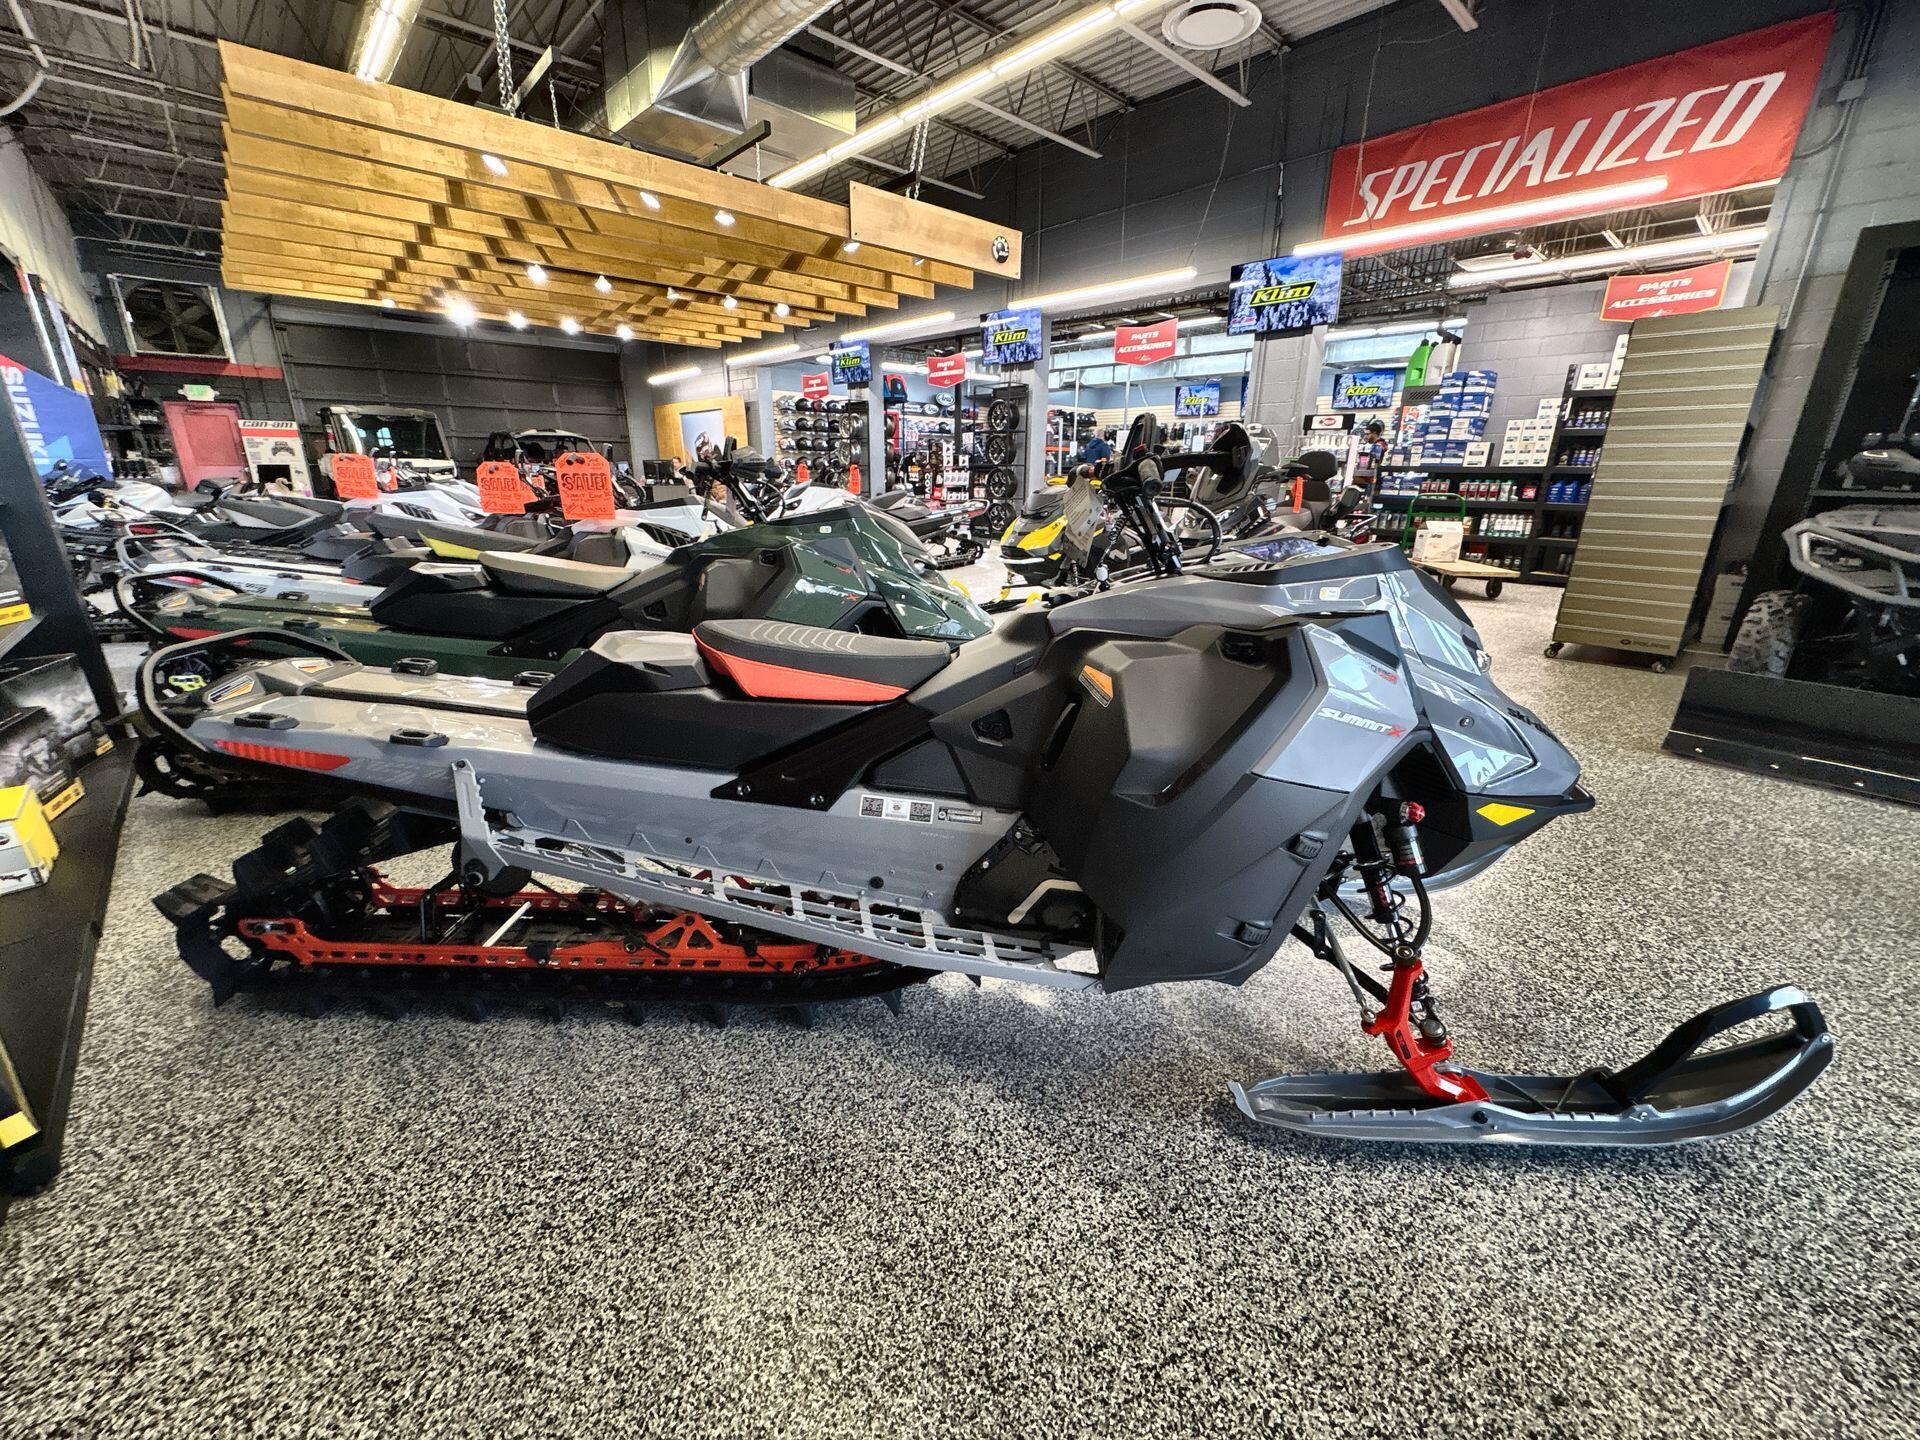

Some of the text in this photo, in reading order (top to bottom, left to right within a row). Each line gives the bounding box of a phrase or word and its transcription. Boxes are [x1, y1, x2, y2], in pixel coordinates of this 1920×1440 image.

[1342, 71, 1786, 227] SPECIALIZED
[1637, 278, 1693, 292] PARTS
[1252, 285, 1311, 304] Klim
[1608, 288, 1717, 309] ACCESSORIES
[995, 331, 1026, 342] Klim
[1131, 331, 1159, 340] PARTS
[1117, 341, 1173, 353] ACCESSORIES
[840, 357, 860, 368] Klim
[1346, 387, 1378, 395] Klim
[0, 366, 51, 465] SUZUKI
